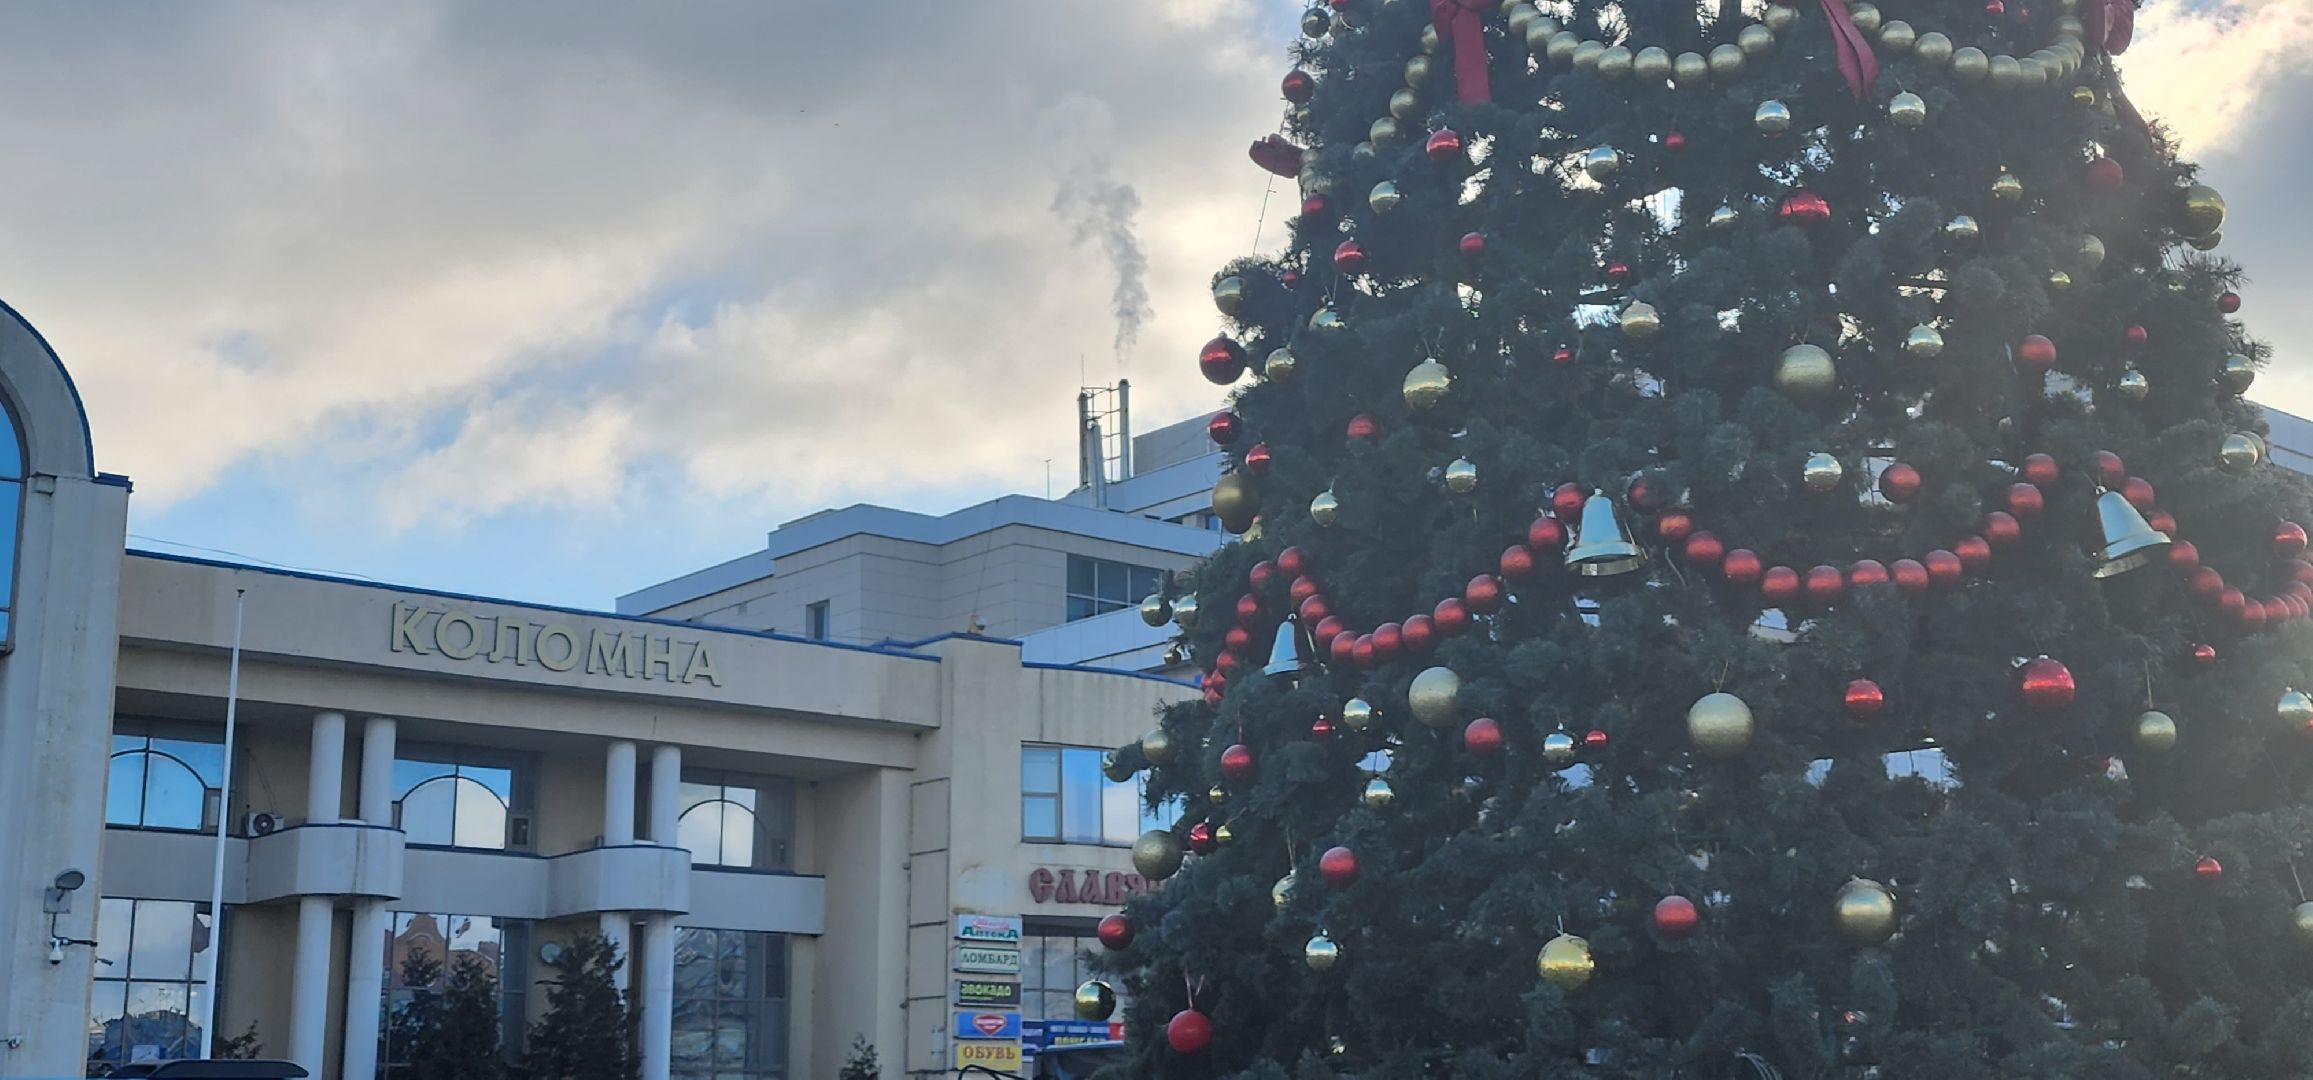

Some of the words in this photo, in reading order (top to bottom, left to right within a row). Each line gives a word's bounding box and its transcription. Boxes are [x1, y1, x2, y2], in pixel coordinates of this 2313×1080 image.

[391, 600, 722, 687] КОЛОМНА
[961, 952, 1017, 966] ЛОМБАРД
[963, 1046, 1016, 1061] ОБУВЬ
